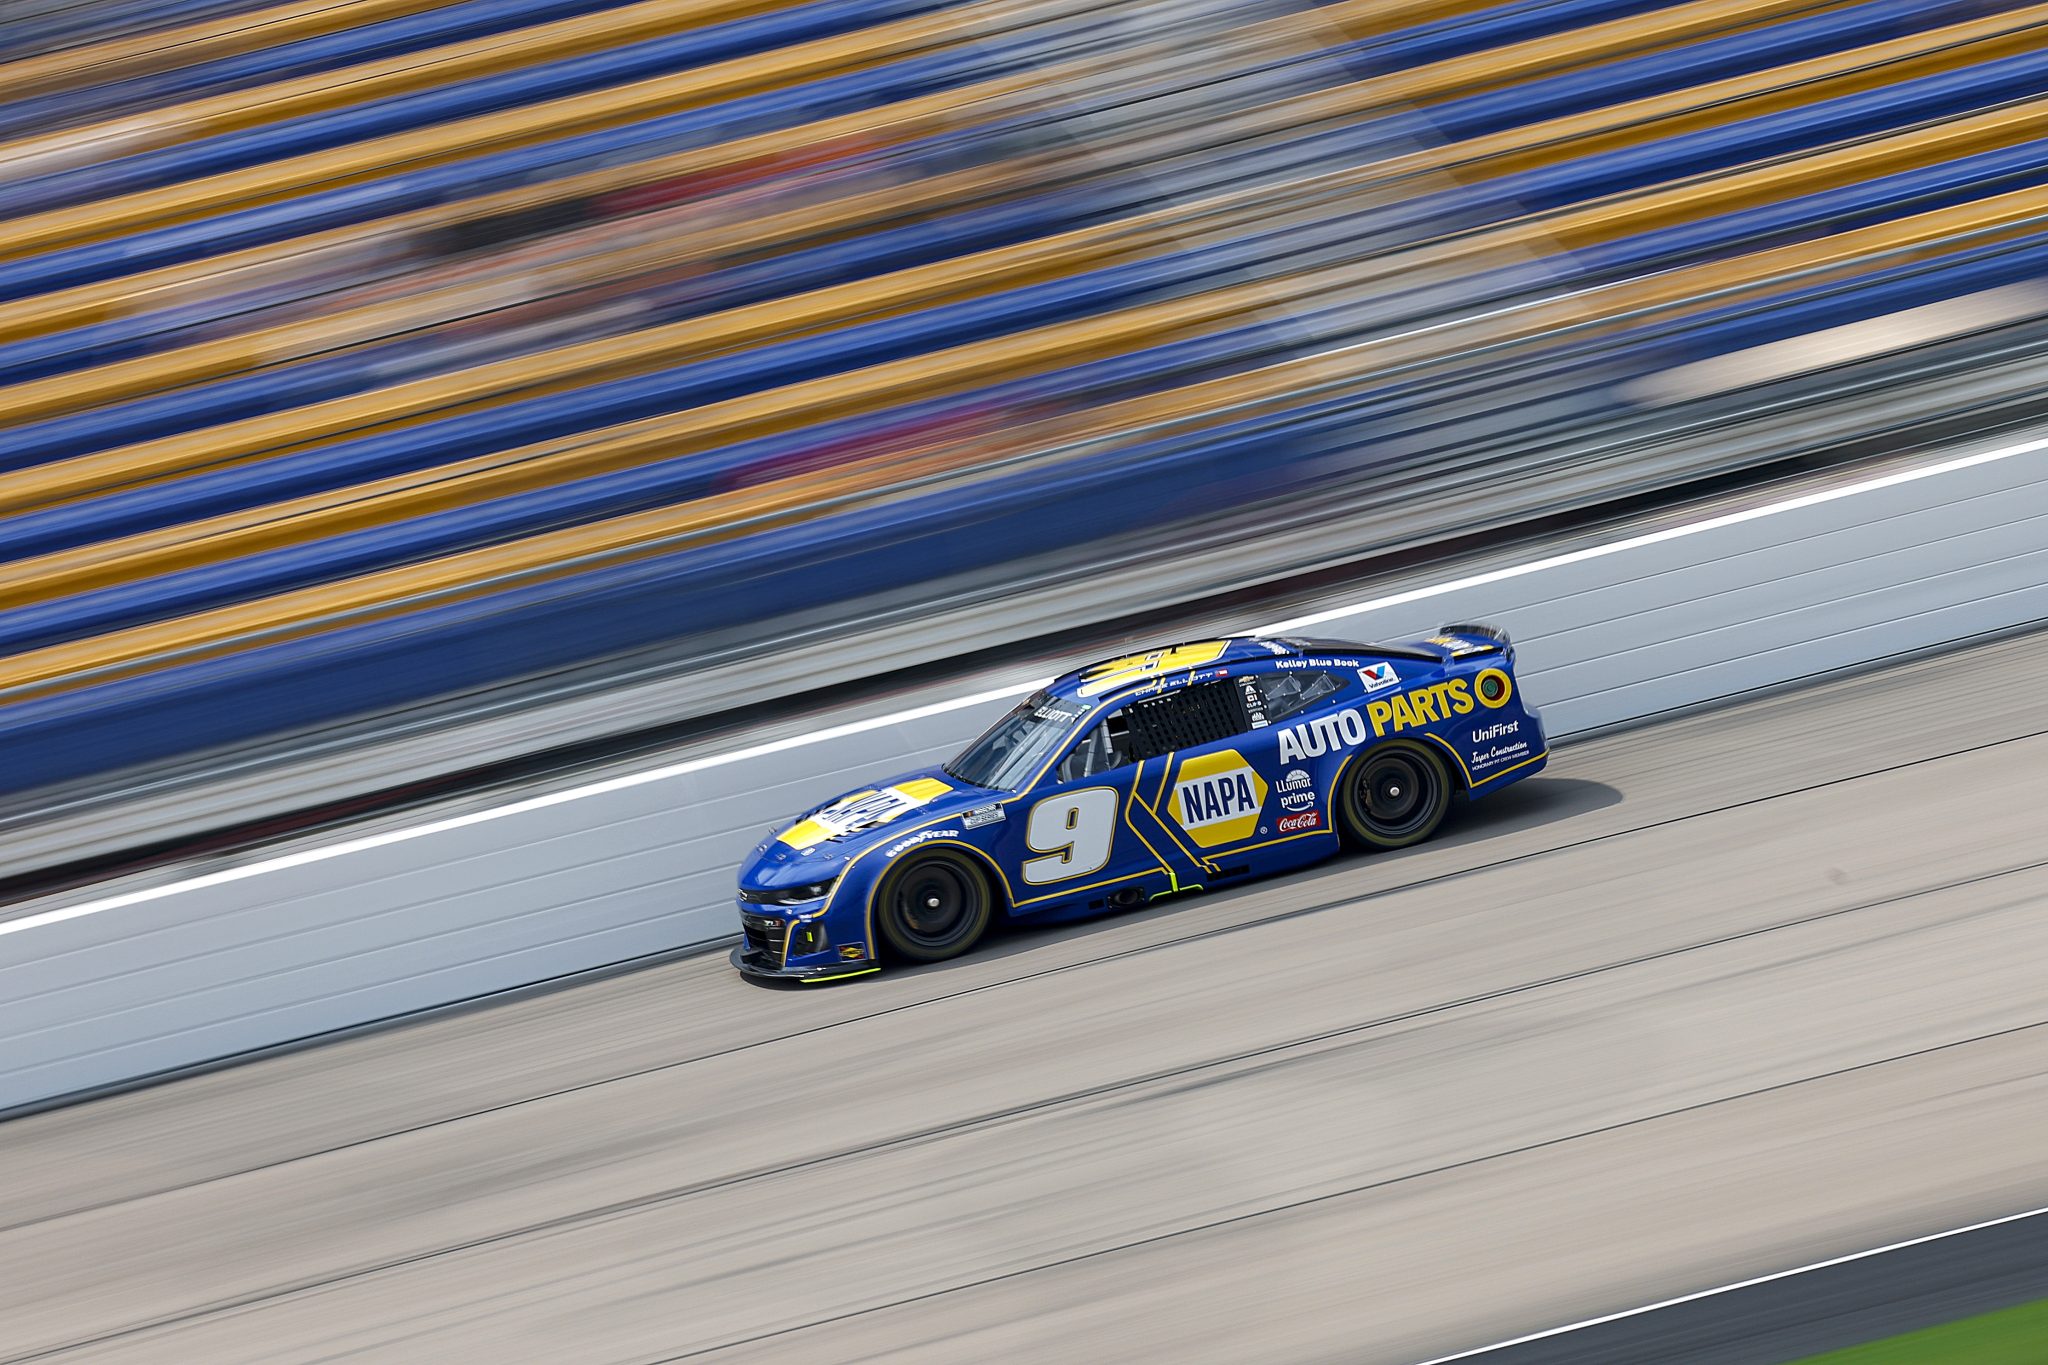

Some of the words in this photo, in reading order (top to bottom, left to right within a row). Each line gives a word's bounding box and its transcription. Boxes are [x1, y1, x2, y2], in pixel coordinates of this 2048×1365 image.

[1275, 659, 1307, 669] Kelley
[1308, 658, 1332, 667] Blue
[1333, 658, 1359, 667] Book
[1369, 677, 1394, 689] Valvoline
[1277, 708, 1367, 765] AUTO
[1366, 678, 1475, 738] PARTS
[1472, 720, 1519, 743] UniFirst
[1182, 773, 1255, 824] NAPA
[1280, 791, 1316, 809] prime
[885, 829, 959, 858] GOODYEAR
[1021, 785, 1120, 886] 9
